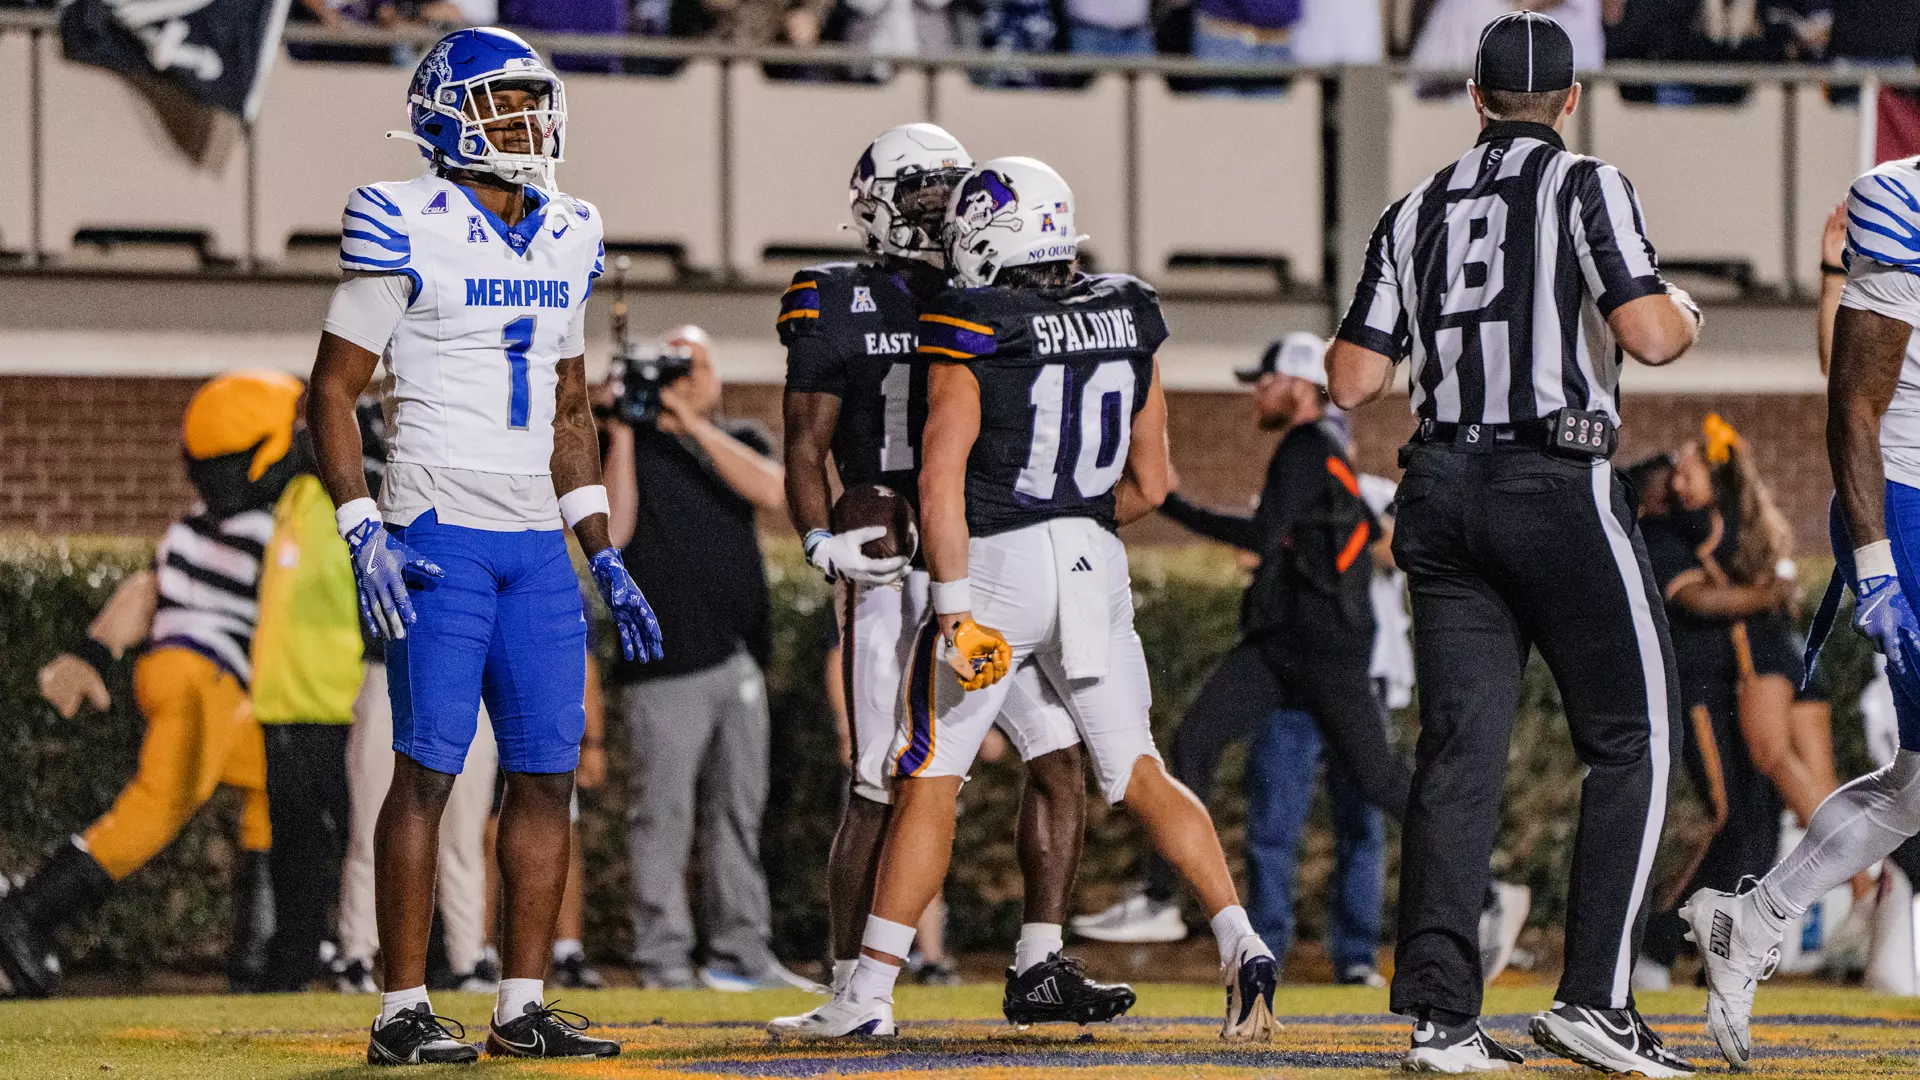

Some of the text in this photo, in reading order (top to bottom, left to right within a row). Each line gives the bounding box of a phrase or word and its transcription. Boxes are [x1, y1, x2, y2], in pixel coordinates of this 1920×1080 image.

[467, 215, 489, 243] A
[1027, 248, 1046, 261] NO
[1440, 193, 1509, 316] B
[464, 278, 570, 309] MEMPHIS
[864, 332, 911, 355] EAST
[1032, 308, 1138, 355] SPALDING
[500, 314, 538, 431] 1
[1013, 360, 1136, 500] 10
[1709, 908, 1734, 960] NIKE
